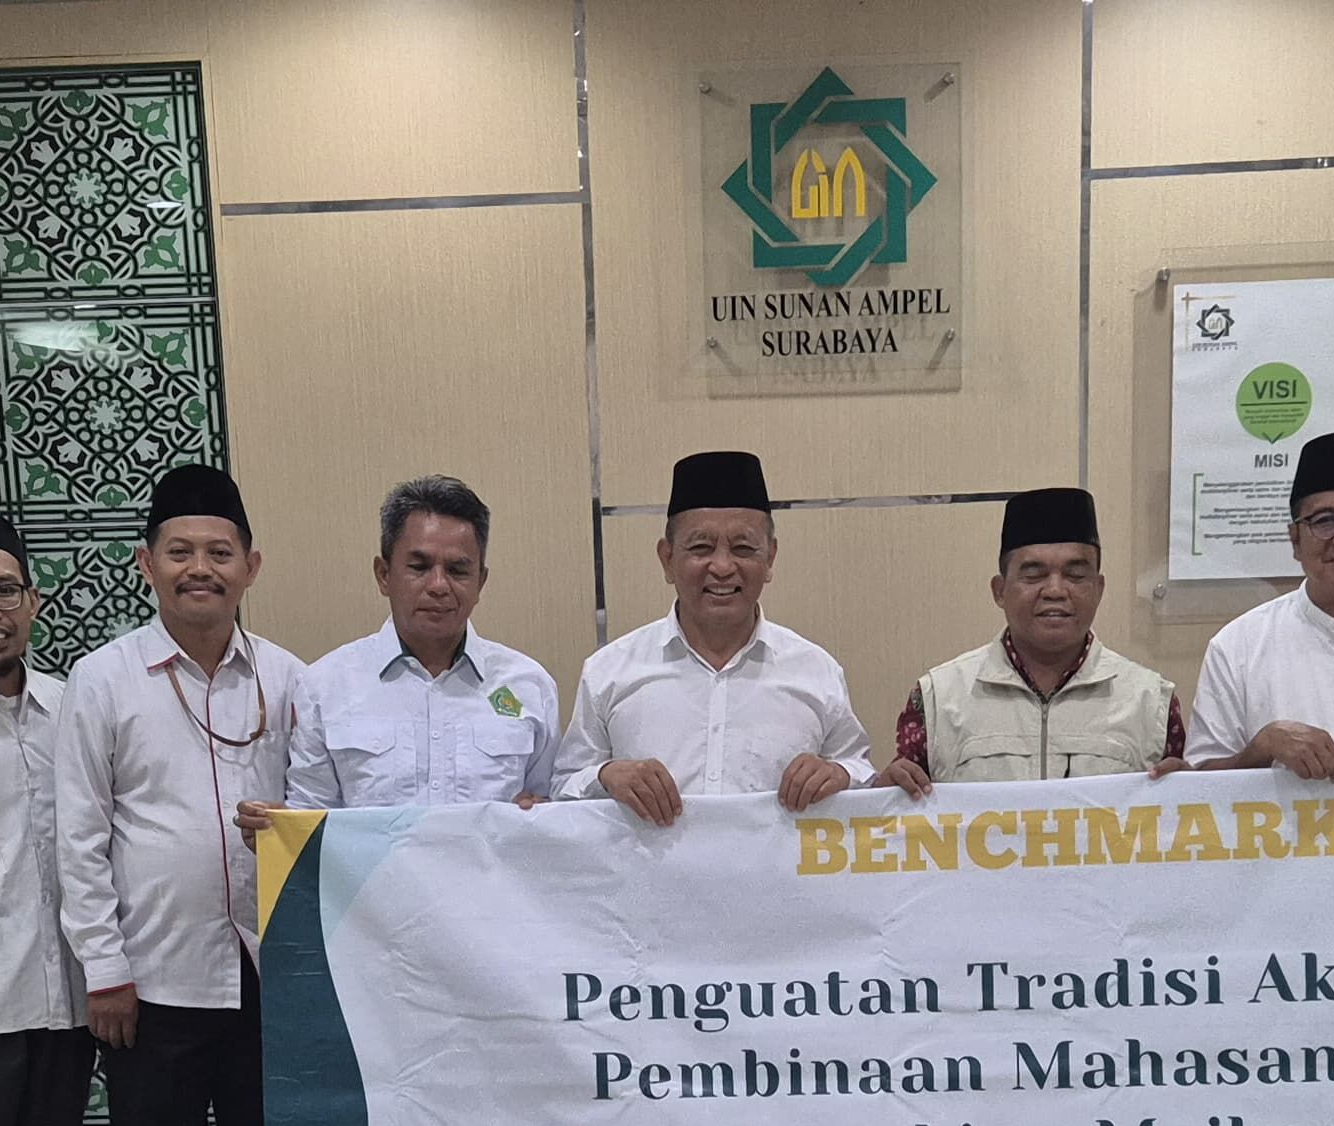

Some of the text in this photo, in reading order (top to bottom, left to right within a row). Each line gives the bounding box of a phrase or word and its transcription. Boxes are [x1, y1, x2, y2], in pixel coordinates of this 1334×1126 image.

[712, 288, 950, 322] UIN SUNAN AMPEL
[762, 328, 898, 357] SURABAYA
[1253, 379, 1297, 400] VISI
[1254, 453, 1289, 468] MISI
[561, 970, 942, 1033] Penguatan
[966, 955, 1224, 1012] Tradisi
[592, 1048, 986, 1101] Pembinaan
